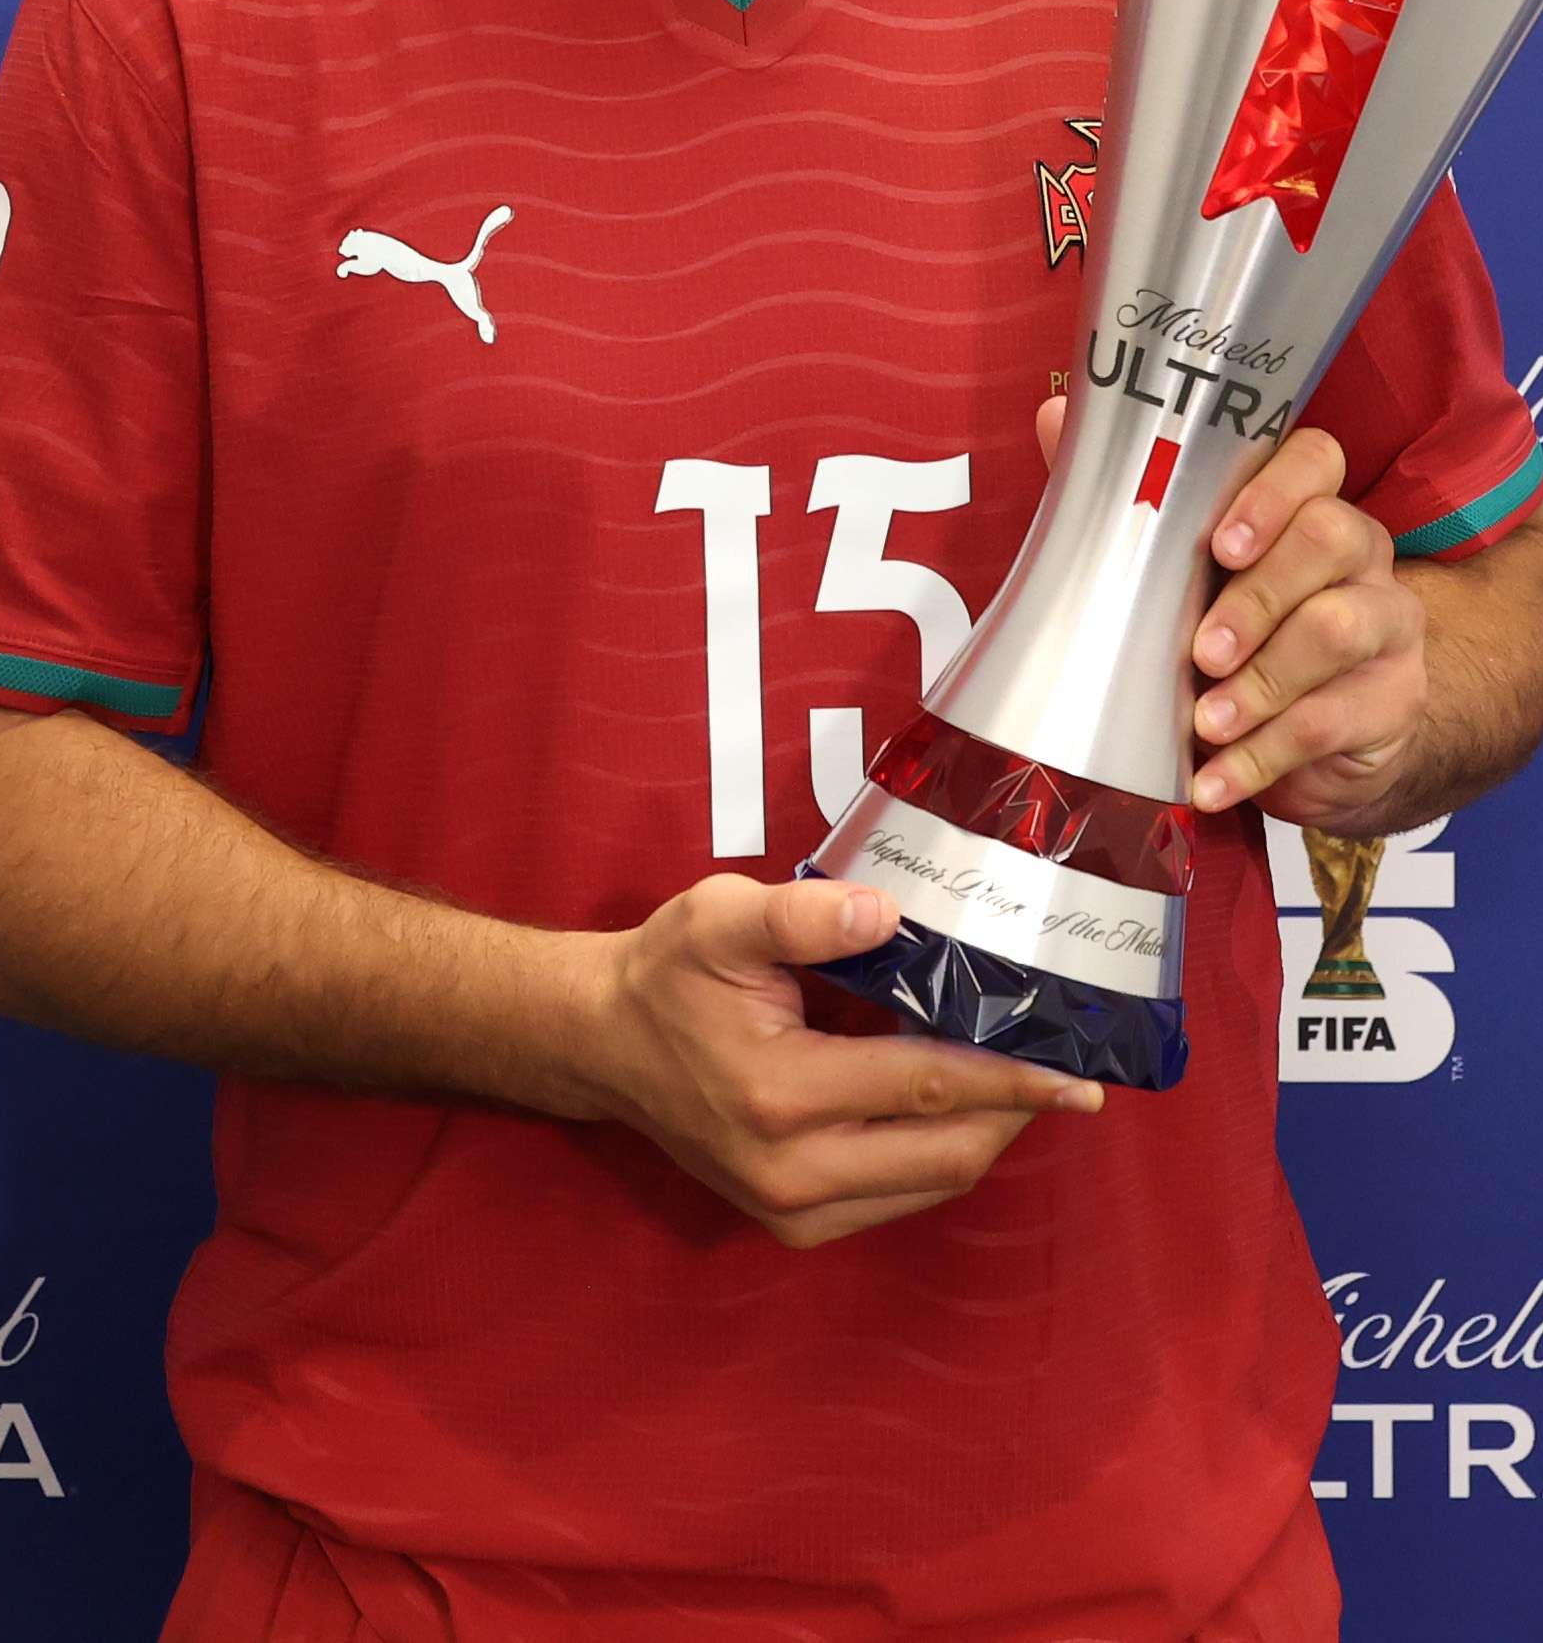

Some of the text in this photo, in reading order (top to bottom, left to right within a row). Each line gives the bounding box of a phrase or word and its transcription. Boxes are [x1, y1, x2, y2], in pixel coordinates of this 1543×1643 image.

[1117, 289, 1294, 374] Michelob
[1087, 329, 1293, 449] ULTRA
[654, 452, 972, 859] 15
[861, 829, 947, 884] Superior
[1038, 911, 1090, 935] of
[1068, 917, 1106, 943] the
[1297, 1016, 1396, 1051] FIFA
